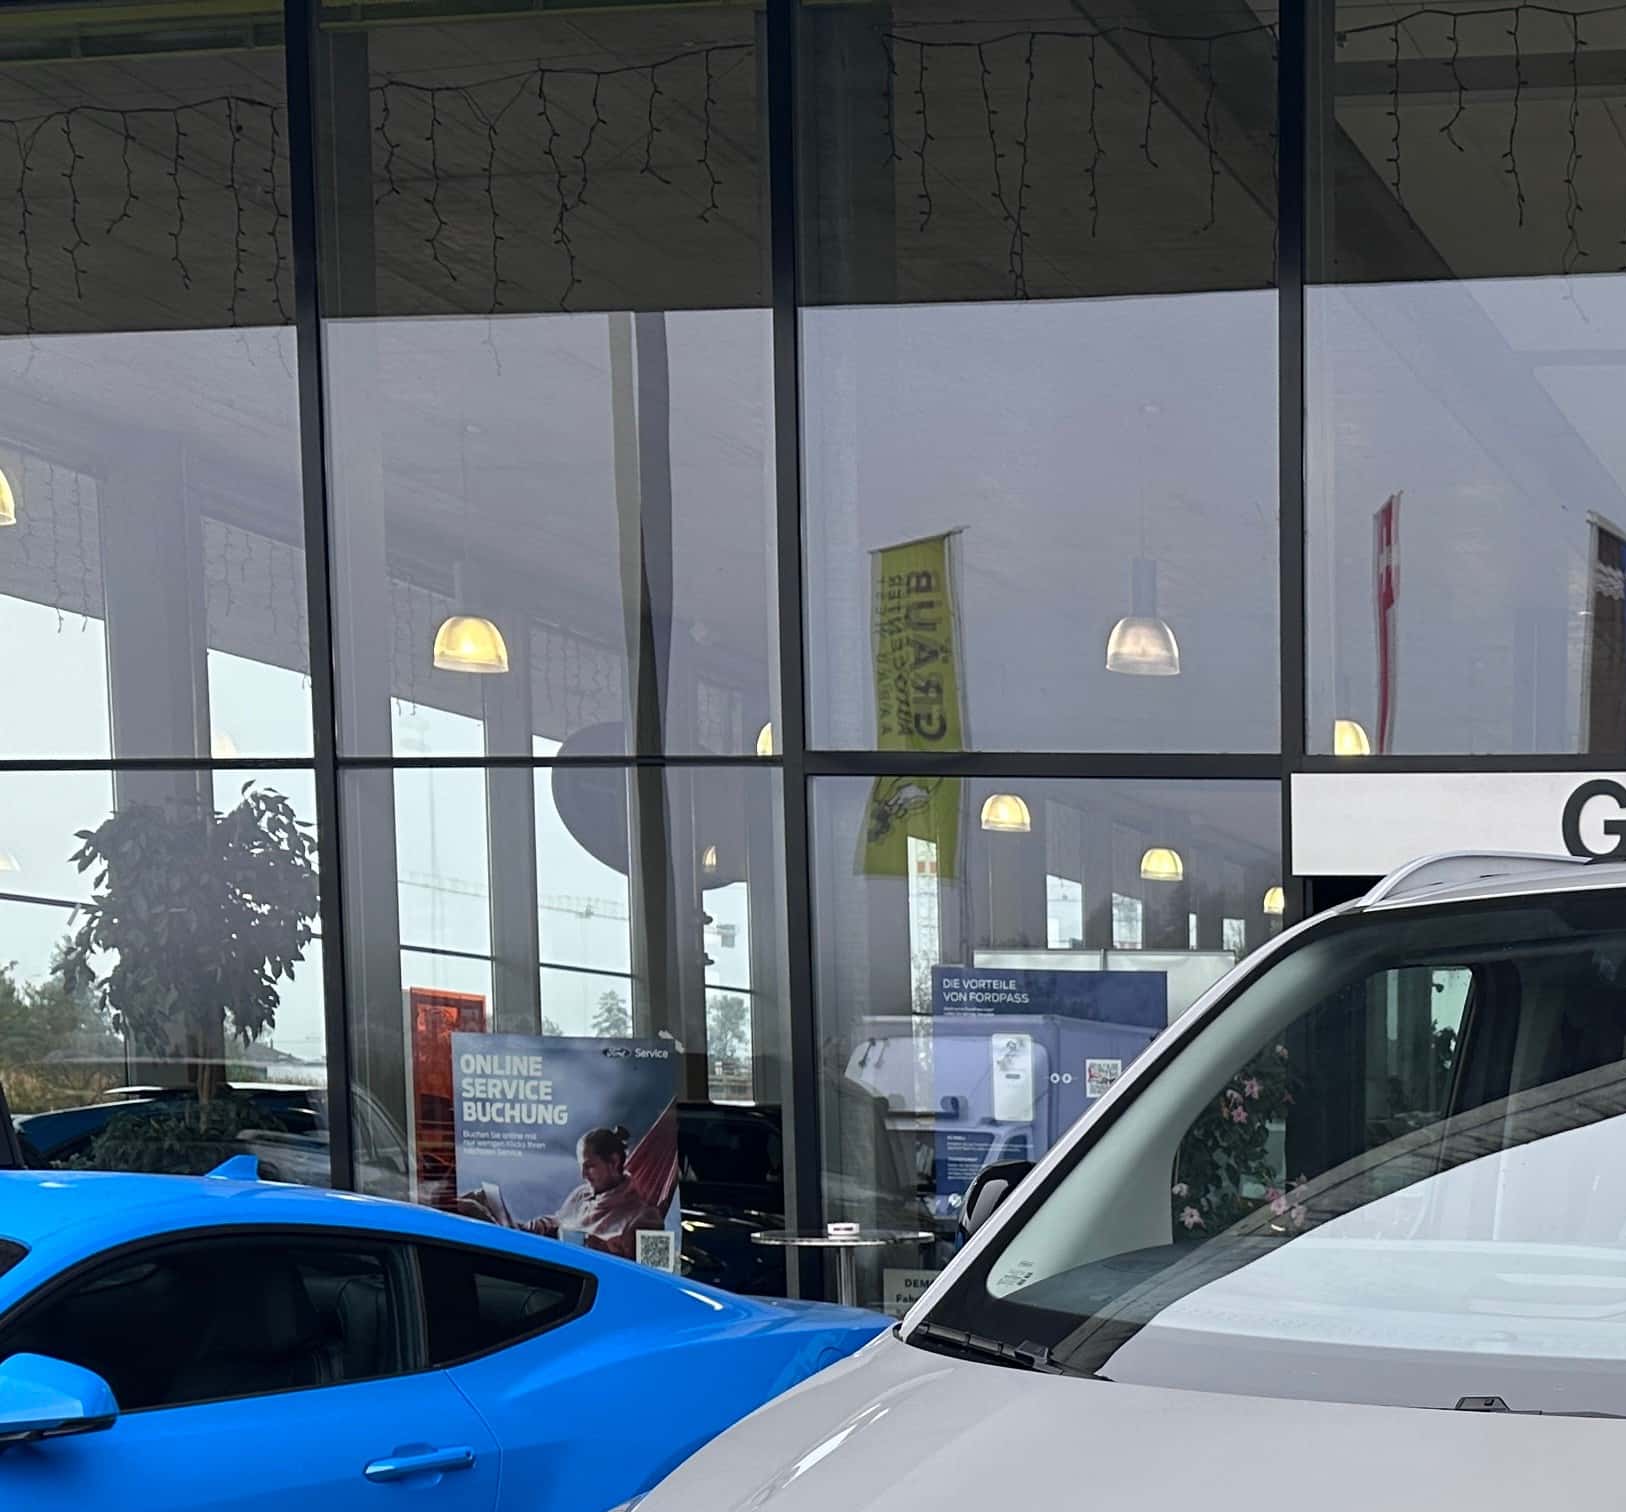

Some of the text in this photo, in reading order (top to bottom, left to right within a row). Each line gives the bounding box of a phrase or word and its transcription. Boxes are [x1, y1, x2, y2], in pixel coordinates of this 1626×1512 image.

[943, 978, 1017, 990] DIE VORTEILE
[943, 991, 1030, 1004] VON FORDPASS
[635, 1048, 669, 1059] Service
[460, 1054, 543, 1077] ONLINE
[461, 1079, 553, 1101] SERVICE
[463, 1102, 569, 1125] BUCHUNG
